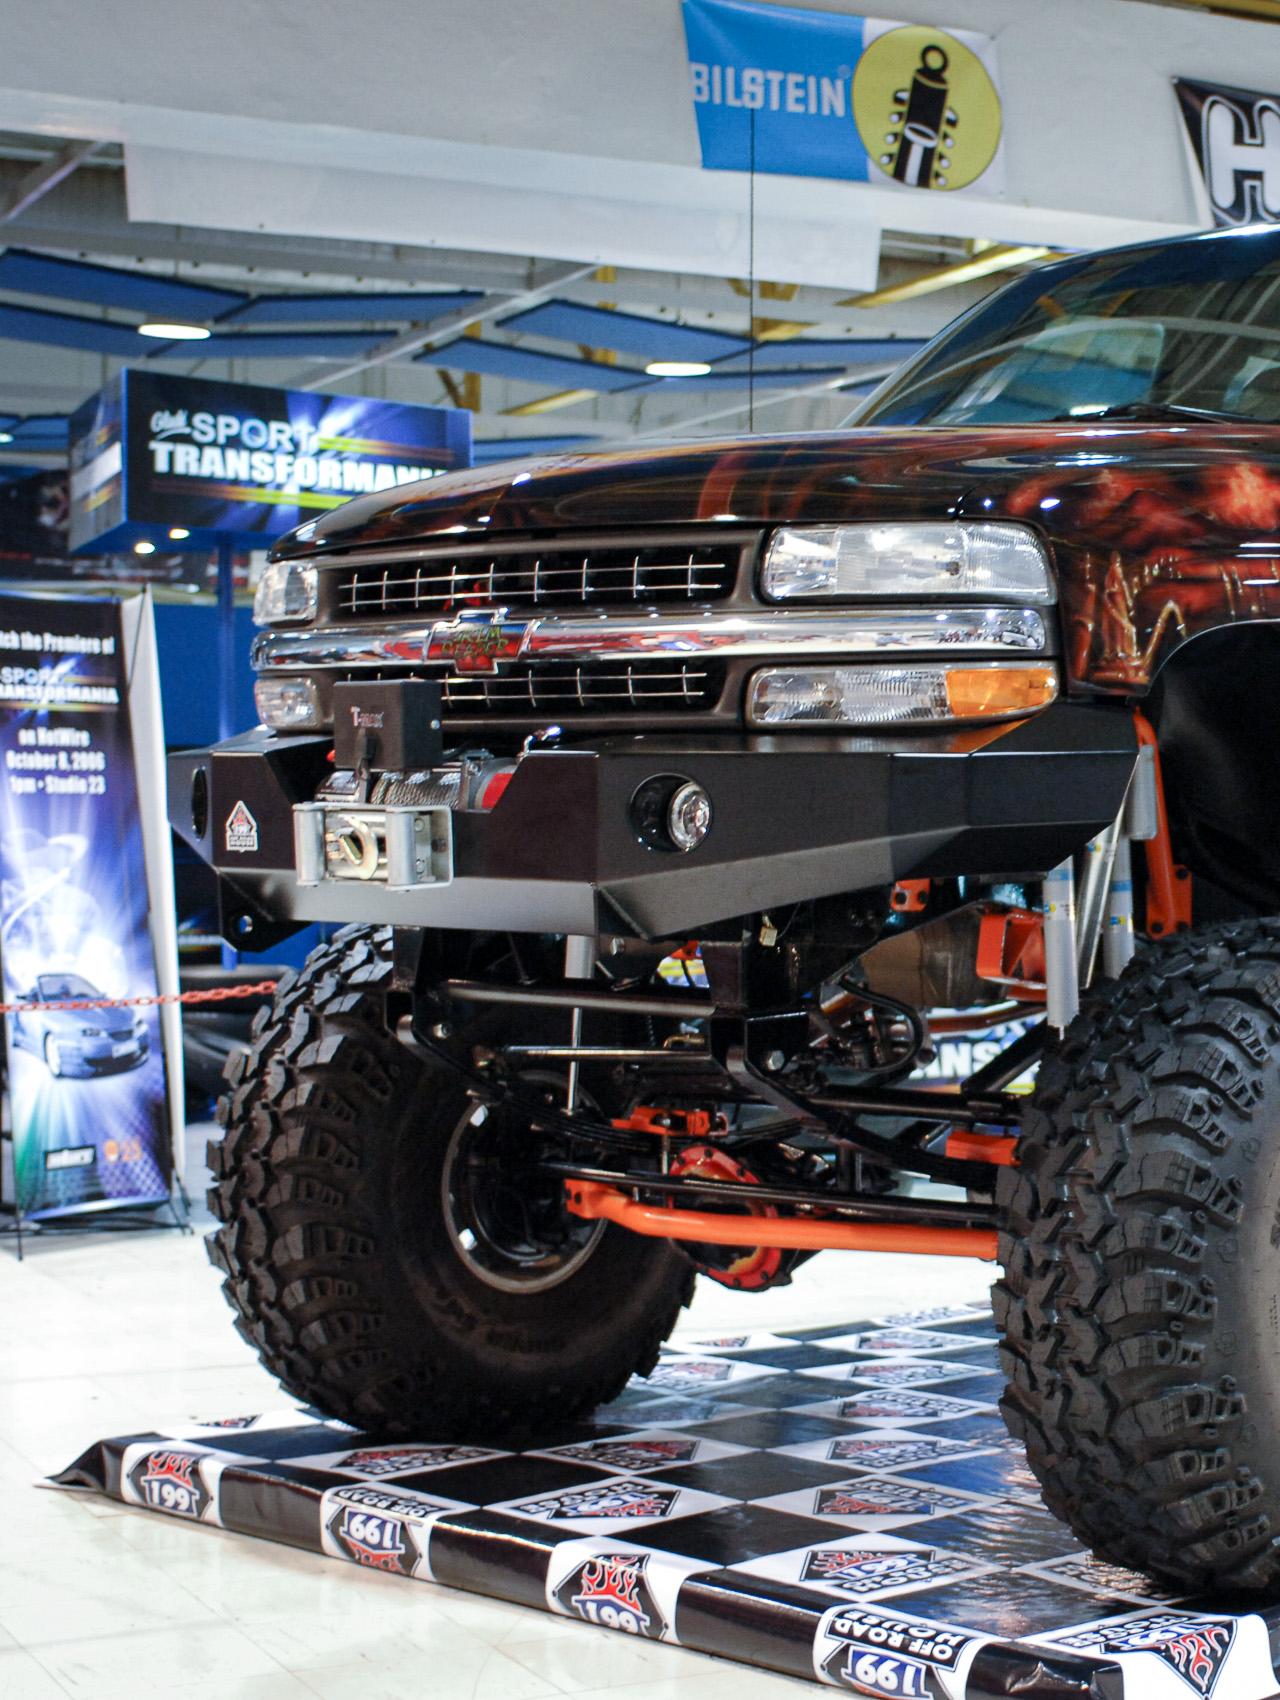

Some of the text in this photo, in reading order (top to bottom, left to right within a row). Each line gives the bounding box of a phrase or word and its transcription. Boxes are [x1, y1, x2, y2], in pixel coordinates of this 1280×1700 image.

[689, 61, 846, 117] BILSTEIN
[20, 631, 42, 651] the
[18, 729, 36, 746] on
[6, 750, 57, 769] October
[45, 775, 87, 794] Studio
[151, 1480, 190, 1511] 199
[833, 1618, 953, 1661] OFF ROAD
